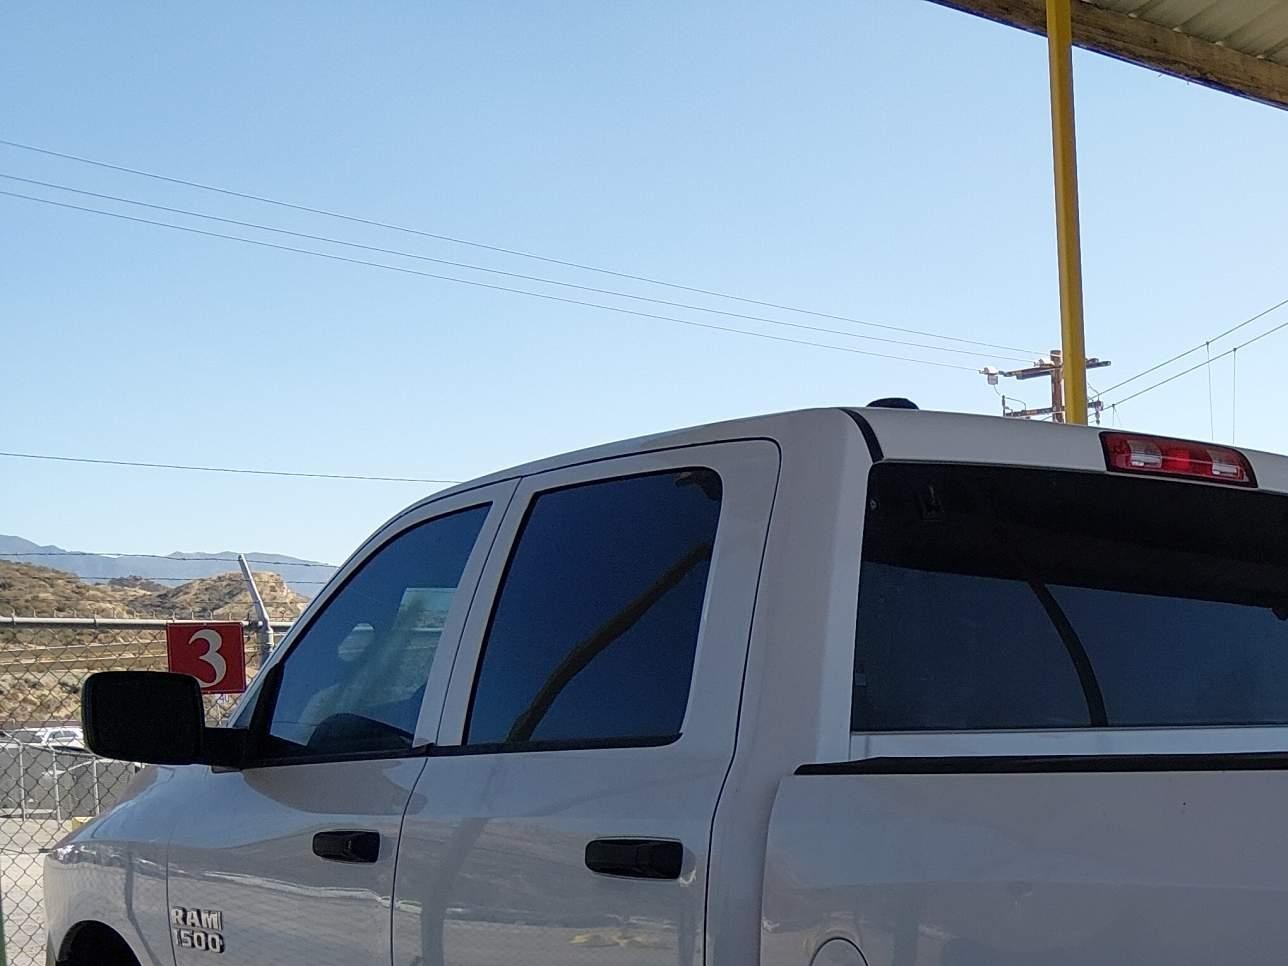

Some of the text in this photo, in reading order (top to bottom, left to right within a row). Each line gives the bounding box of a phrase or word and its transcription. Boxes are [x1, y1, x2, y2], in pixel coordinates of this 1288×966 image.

[188, 629, 227, 688] 3
[171, 907, 223, 931] RAM
[173, 928, 225, 954] 1500
